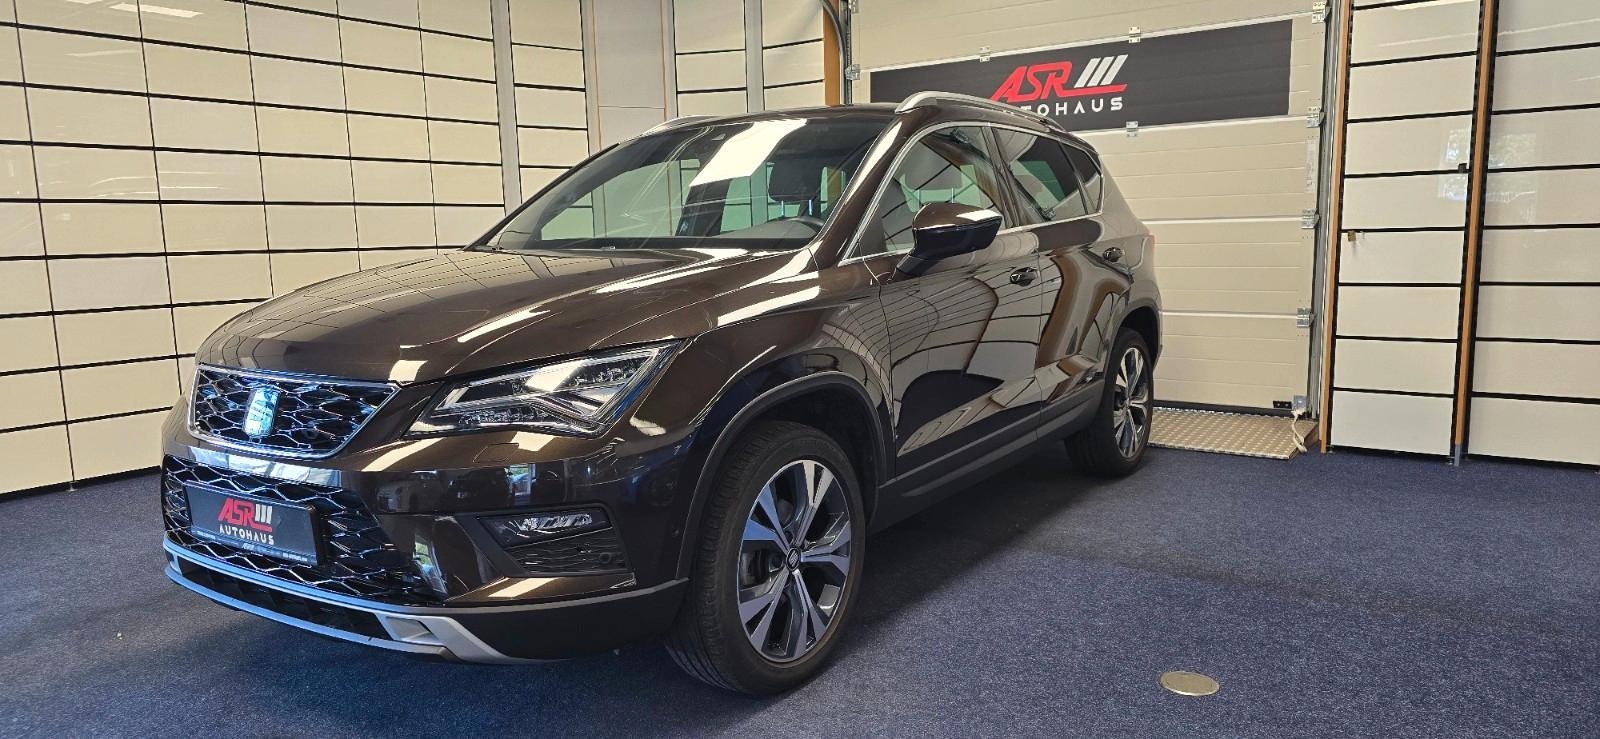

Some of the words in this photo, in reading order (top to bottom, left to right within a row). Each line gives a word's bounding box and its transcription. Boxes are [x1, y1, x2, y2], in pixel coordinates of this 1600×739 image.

[1020, 97, 1123, 116] OHAUS
[218, 498, 272, 532] ASR
[219, 524, 275, 545] AUTOHAUS
